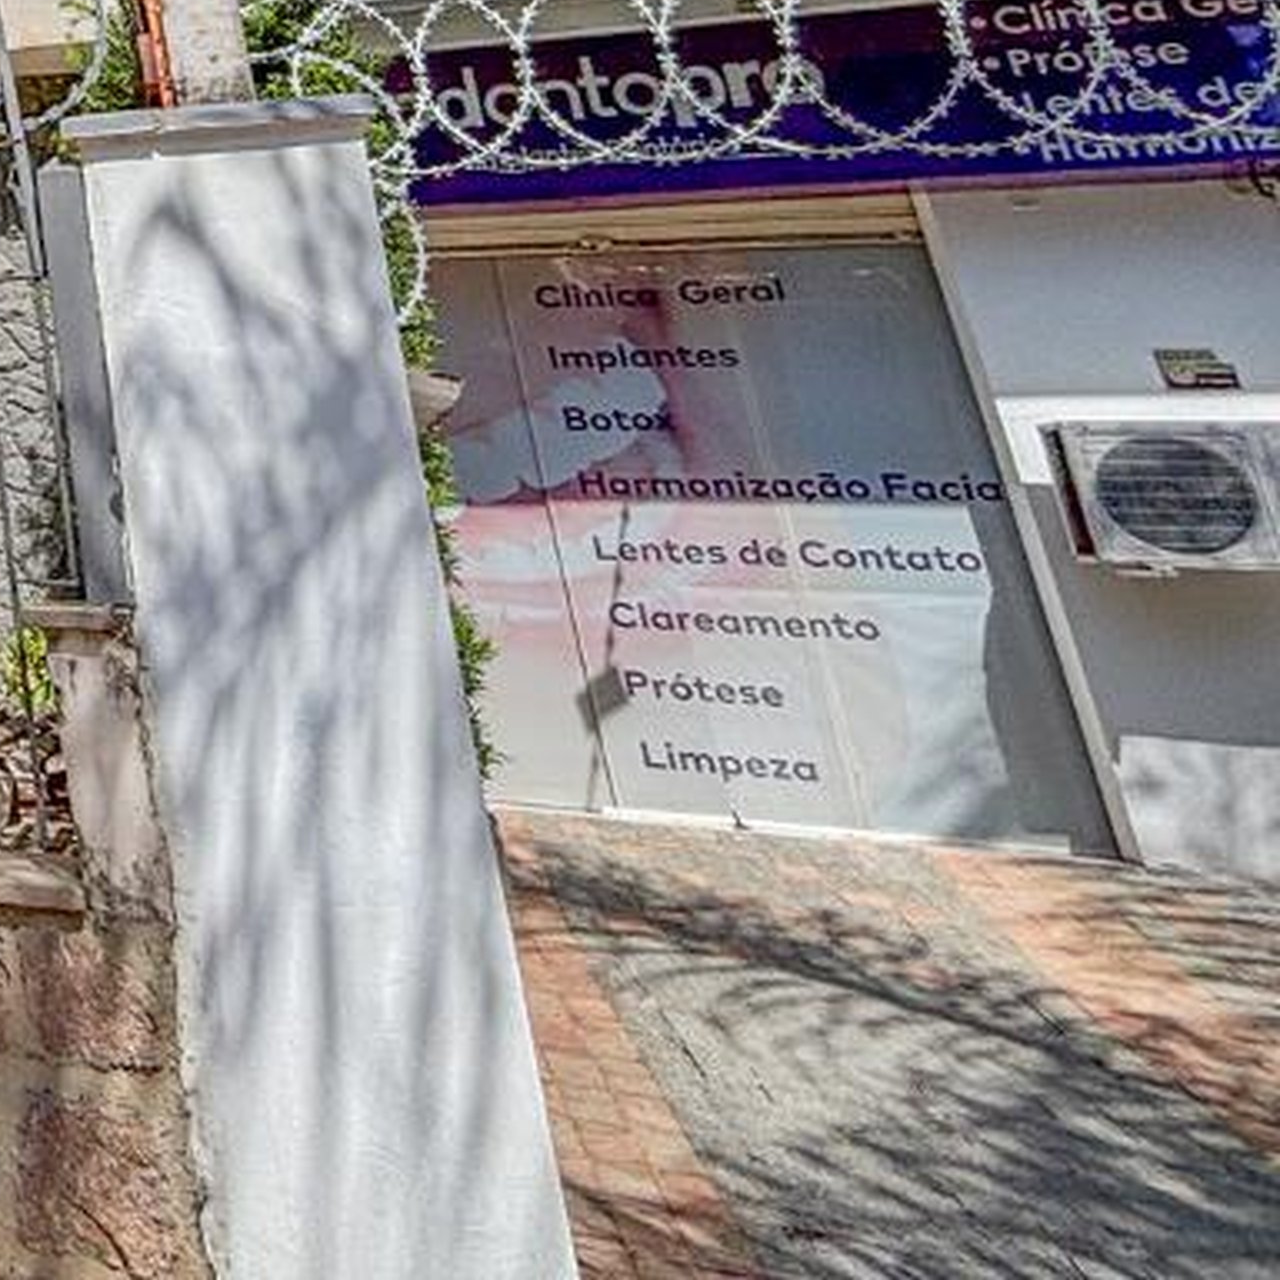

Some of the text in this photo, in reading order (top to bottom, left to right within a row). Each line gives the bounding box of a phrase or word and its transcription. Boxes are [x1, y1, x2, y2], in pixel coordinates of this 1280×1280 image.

[678, 278, 786, 306] Geral
[547, 343, 741, 373] Implantes
[562, 403, 677, 432] Botox
[578, 471, 870, 502] Harmonização
[593, 535, 983, 571] Lentes de Contato
[609, 602, 881, 642] Clareamento
[624, 670, 785, 708] Prótese
[640, 741, 821, 783] Limpeza
